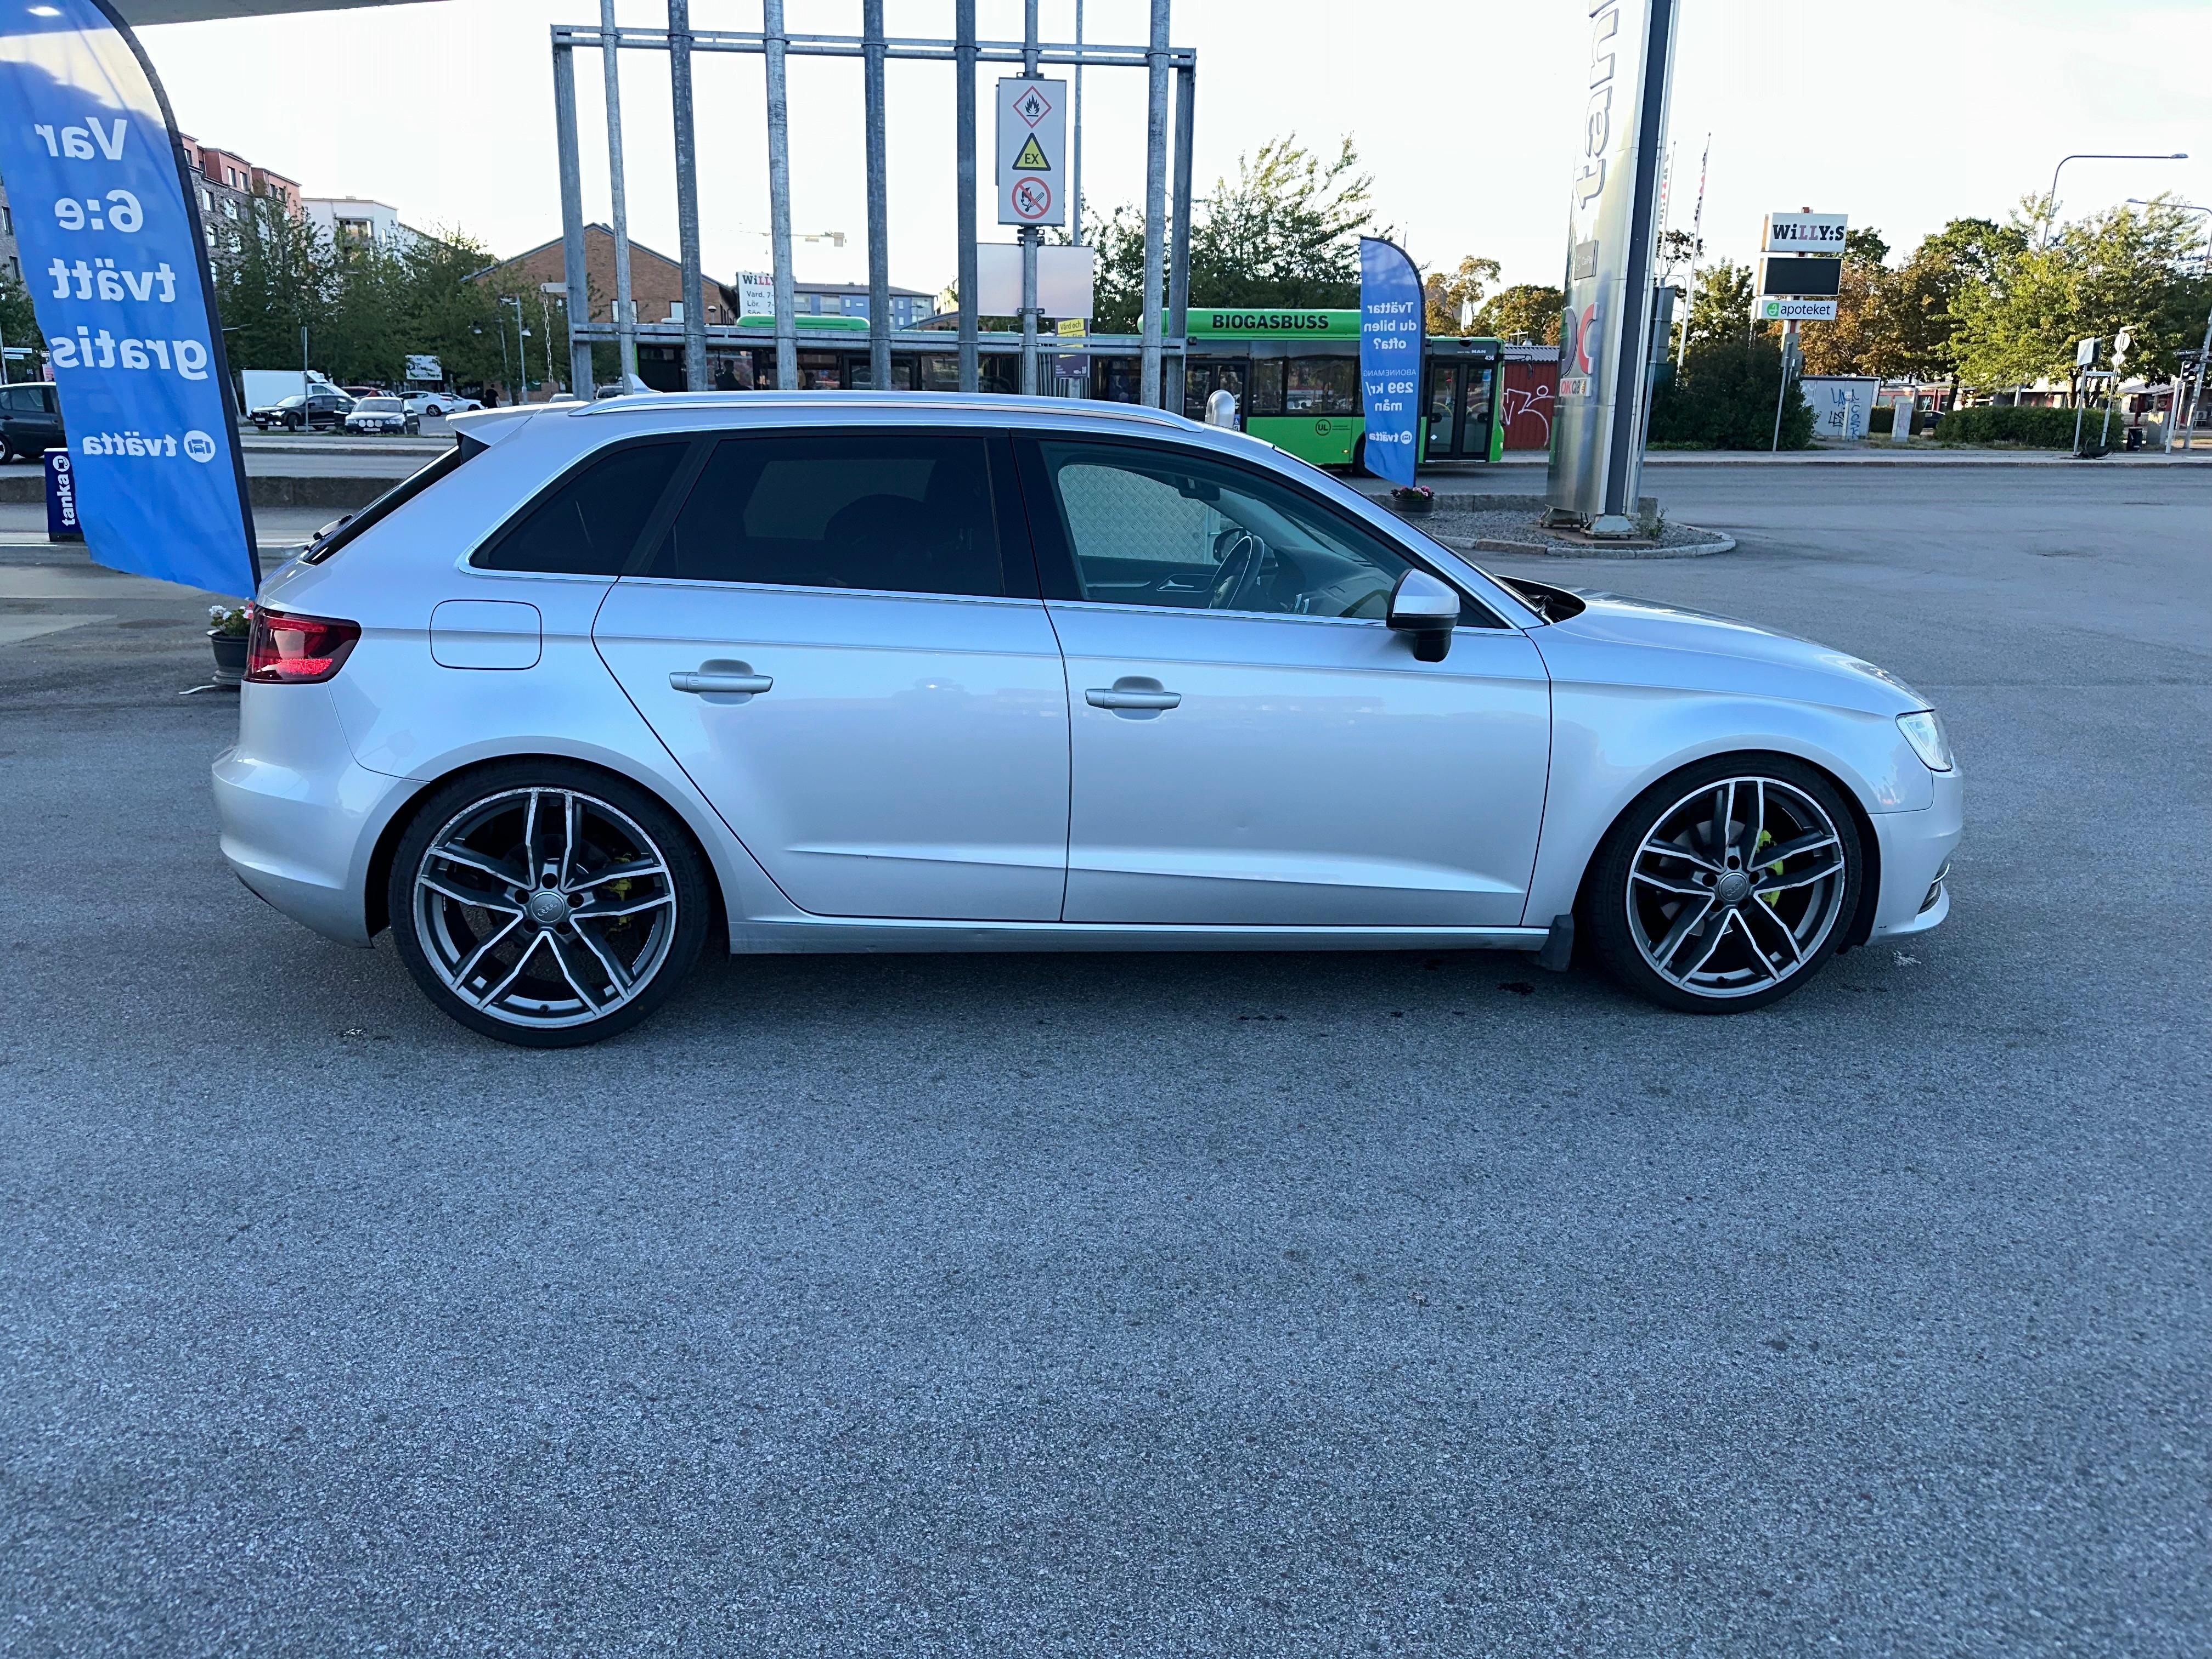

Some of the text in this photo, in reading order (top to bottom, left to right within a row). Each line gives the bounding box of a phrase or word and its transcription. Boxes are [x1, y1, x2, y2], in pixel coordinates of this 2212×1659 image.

[1576, 0, 1618, 210] tan
[1025, 154, 1039, 165] EX
[1773, 223, 1844, 241] WiLLY:S
[1780, 304, 1831, 317] apoteket
[1060, 320, 1081, 330] Vård och
[1212, 314, 1329, 329] BIOGASBUSS
[1561, 380, 1581, 395] OKQ8
[57, 474, 76, 526] tanka
[665, 847, 692, 930] LINGLONG
